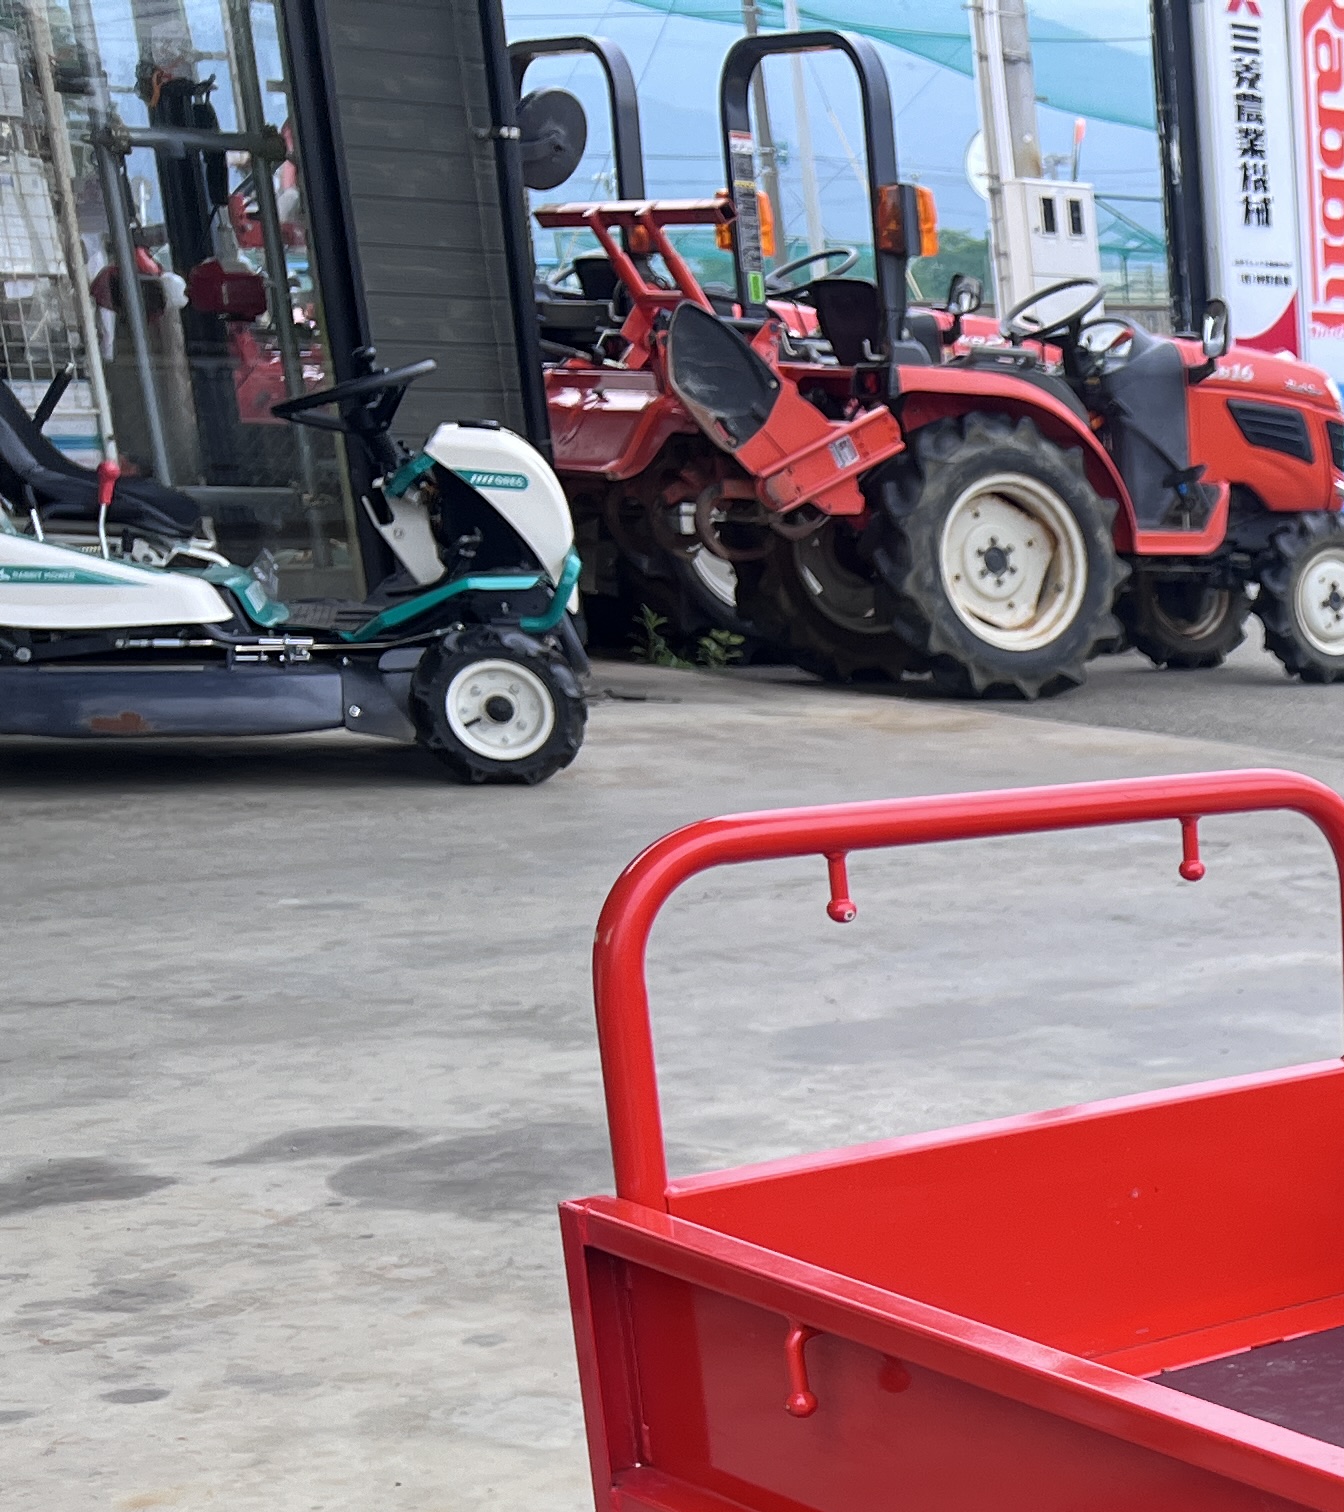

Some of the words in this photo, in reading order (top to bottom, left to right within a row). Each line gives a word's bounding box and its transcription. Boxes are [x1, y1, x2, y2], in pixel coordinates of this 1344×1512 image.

[1230, 22, 1273, 228] 三菱農業機械
